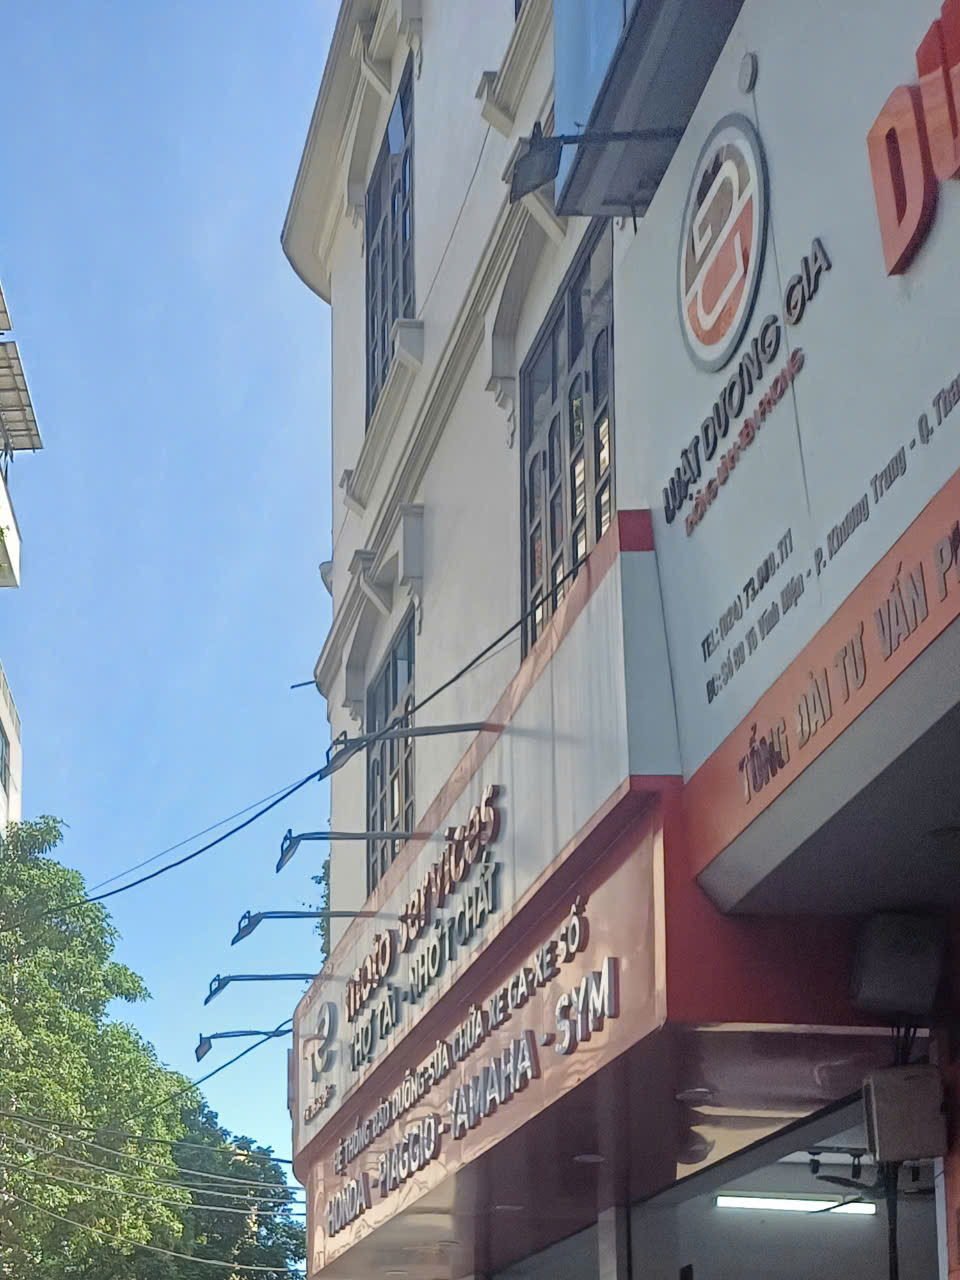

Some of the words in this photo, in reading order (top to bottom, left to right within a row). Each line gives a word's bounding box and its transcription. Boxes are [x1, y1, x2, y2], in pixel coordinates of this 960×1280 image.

[784, 237, 832, 325] GIA
[871, 446, 906, 504] Trung
[739, 722, 790, 805] TỔNG
[796, 667, 833, 750] ĐÀI
[836, 621, 867, 704] TƯ
[876, 560, 929, 662] VẤN
[453, 1002, 489, 1062] CHỮA
[489, 989, 511, 1030] XE
[326, 1172, 372, 1237] HONDA
[379, 1113, 438, 1197] PIAGGIO
[448, 1026, 540, 1140] YAMAHA
[556, 957, 620, 1055] SYM
